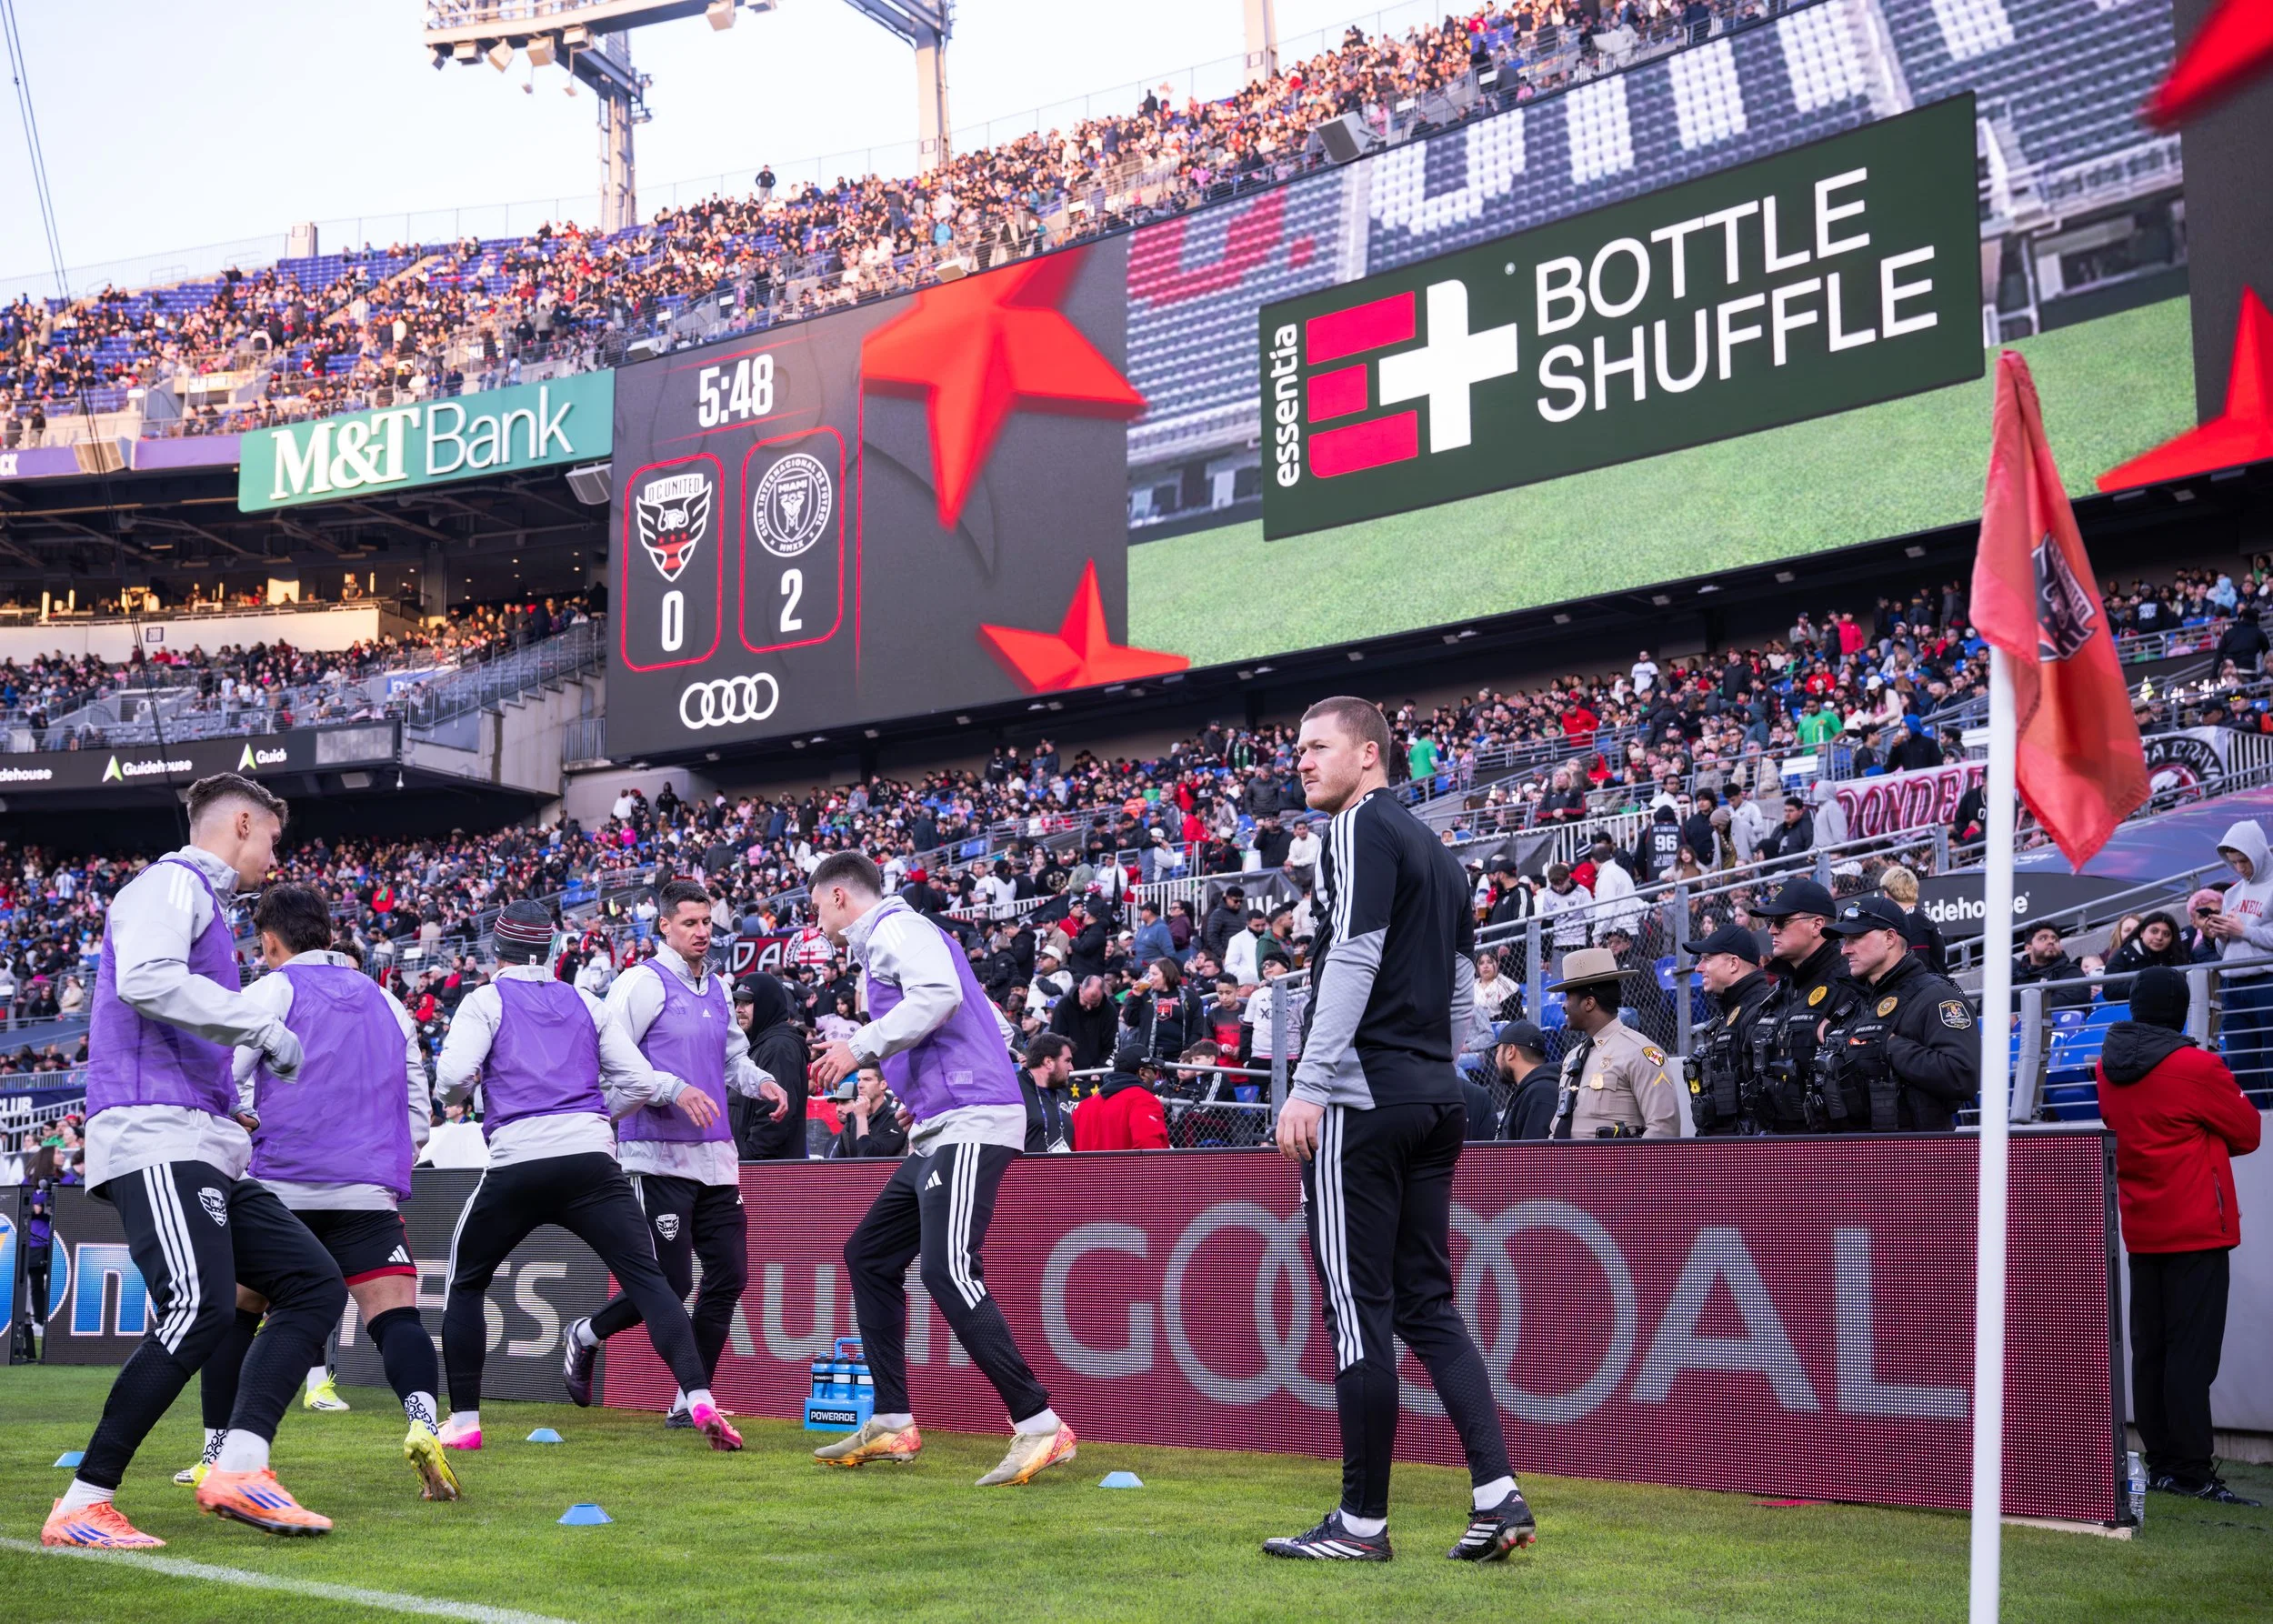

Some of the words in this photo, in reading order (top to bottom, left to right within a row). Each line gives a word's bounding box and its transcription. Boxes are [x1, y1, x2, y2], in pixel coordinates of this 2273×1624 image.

[1535, 166, 1871, 336] BOTTLE
[1537, 244, 1938, 424] SHUFFLE
[698, 354, 775, 428] 5:48
[1268, 322, 1301, 488] essentia
[269, 407, 422, 500] M&T
[426, 385, 576, 476] Bank
[777, 478, 808, 494] MIAMI
[661, 590, 685, 652] 0
[779, 568, 803, 633] 2
[122, 758, 193, 776] Guidehouse
[1655, 835, 1677, 852] 96
[810, 1410, 856, 1422] POWERADE
